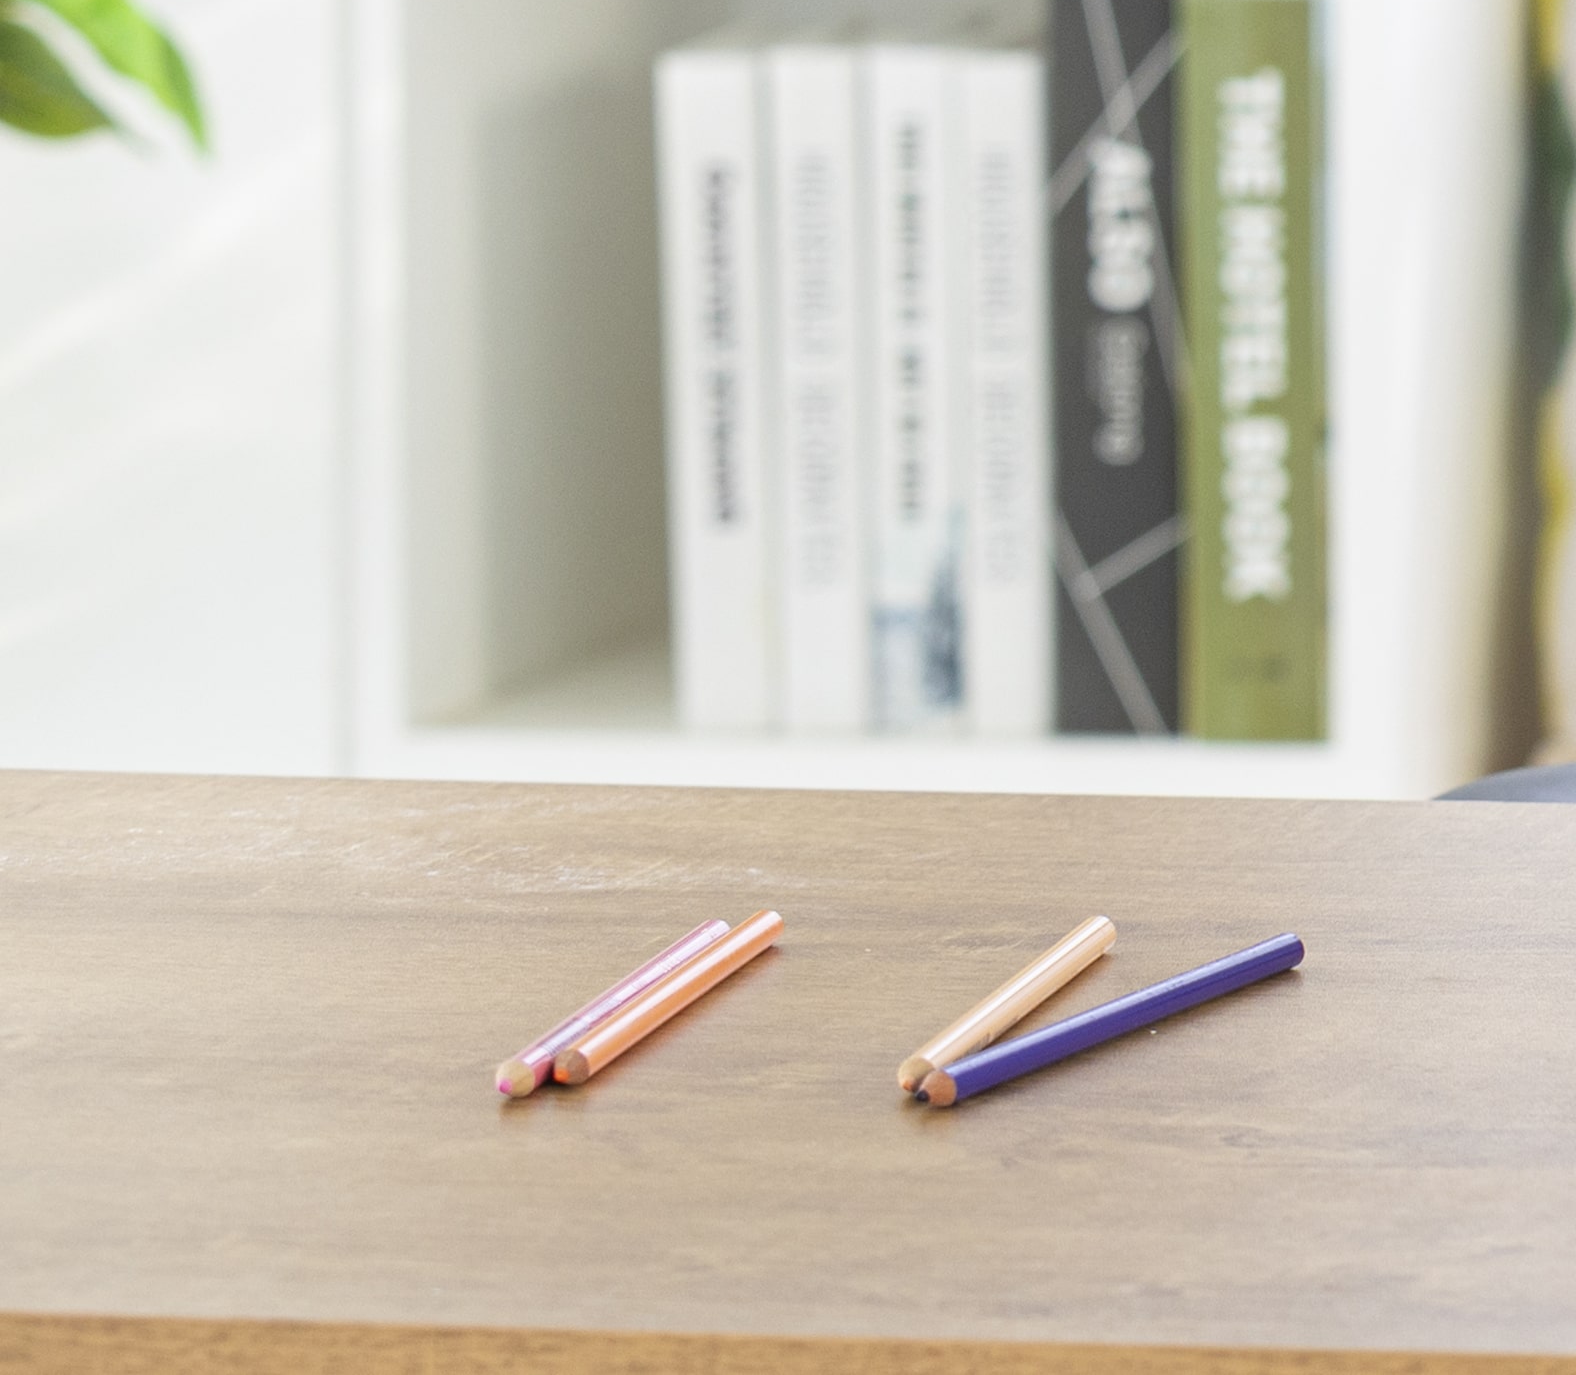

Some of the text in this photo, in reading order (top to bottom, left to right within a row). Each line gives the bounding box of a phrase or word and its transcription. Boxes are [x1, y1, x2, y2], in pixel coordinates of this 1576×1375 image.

[1219, 69, 1291, 603] THE HOTEL BOOK
